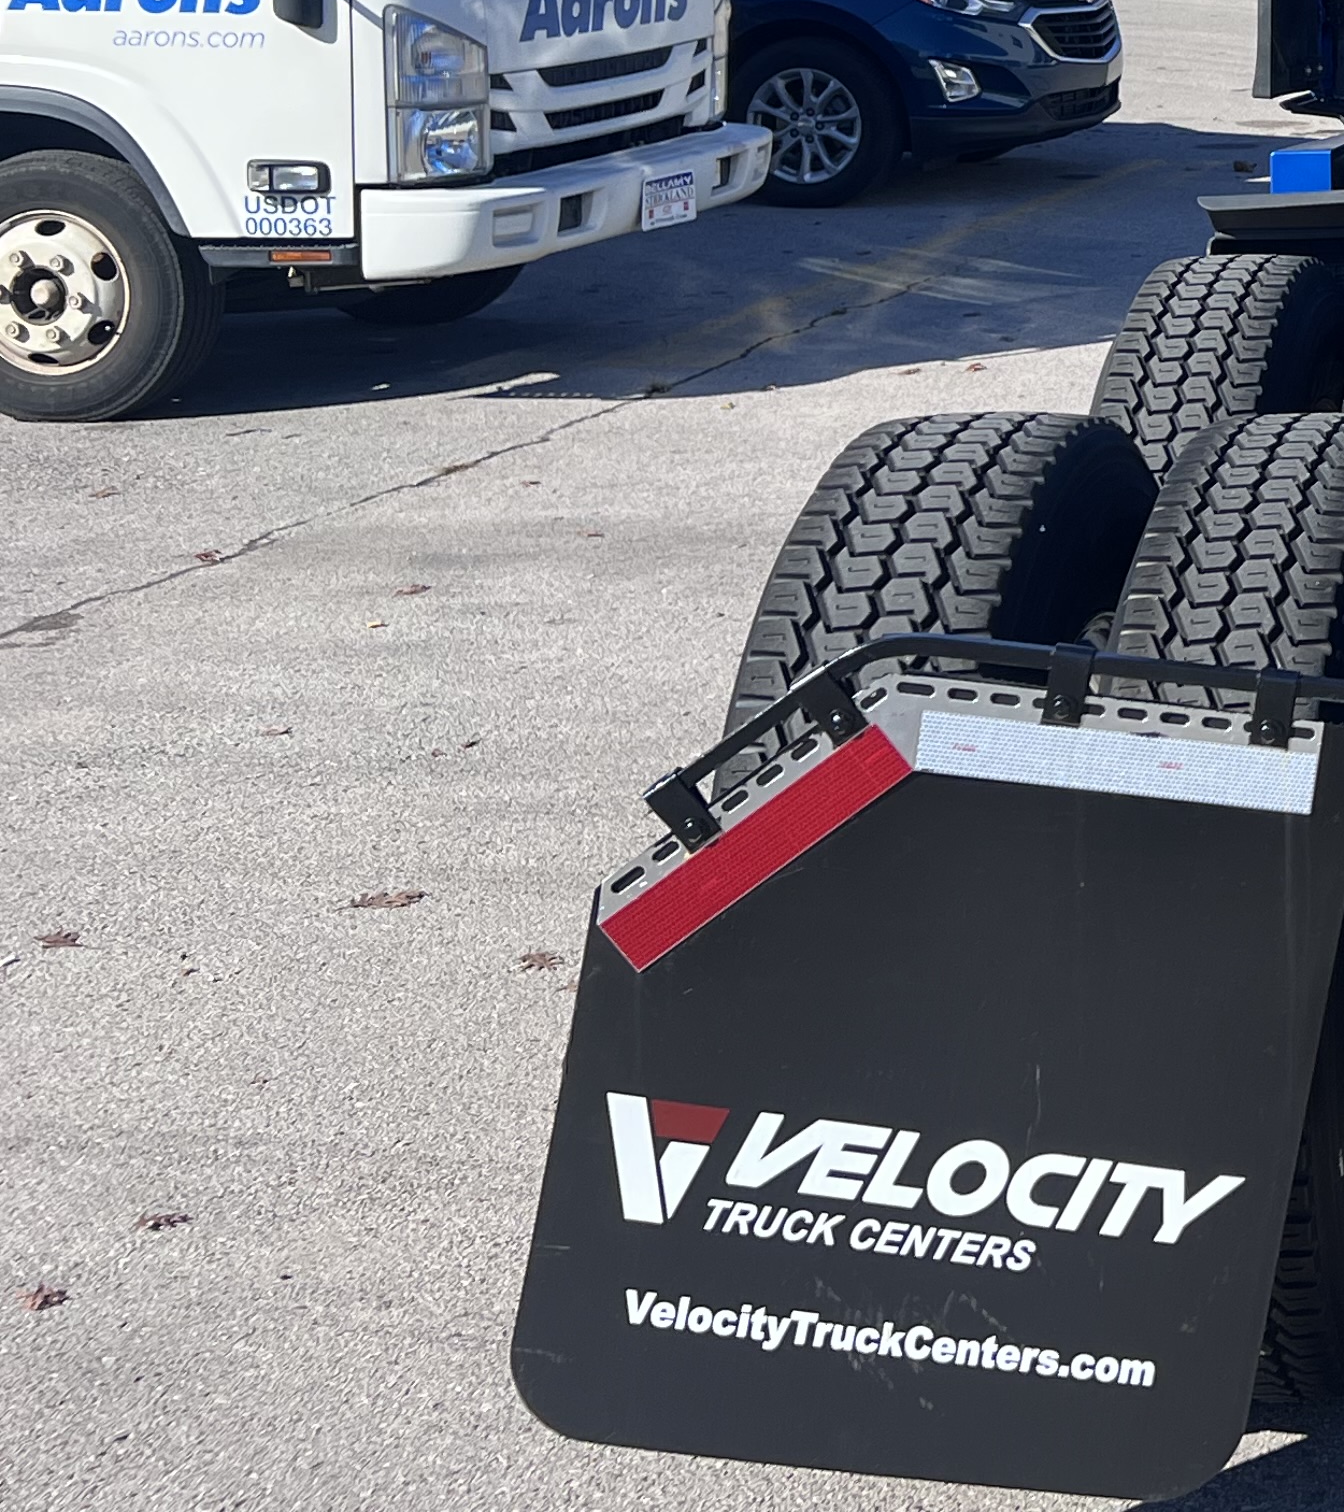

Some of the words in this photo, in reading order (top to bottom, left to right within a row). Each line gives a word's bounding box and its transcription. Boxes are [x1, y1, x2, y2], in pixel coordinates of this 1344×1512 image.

[112, 27, 266, 49] aarons.com
[244, 195, 336, 215] USDOT
[245, 217, 333, 237] 000363
[725, 1111, 1246, 1245] VELOCITY
[702, 1198, 846, 1246] TRUCK
[849, 1218, 1037, 1271] CENTERS
[625, 1288, 1156, 1387] VelocityTruckCenters.com
